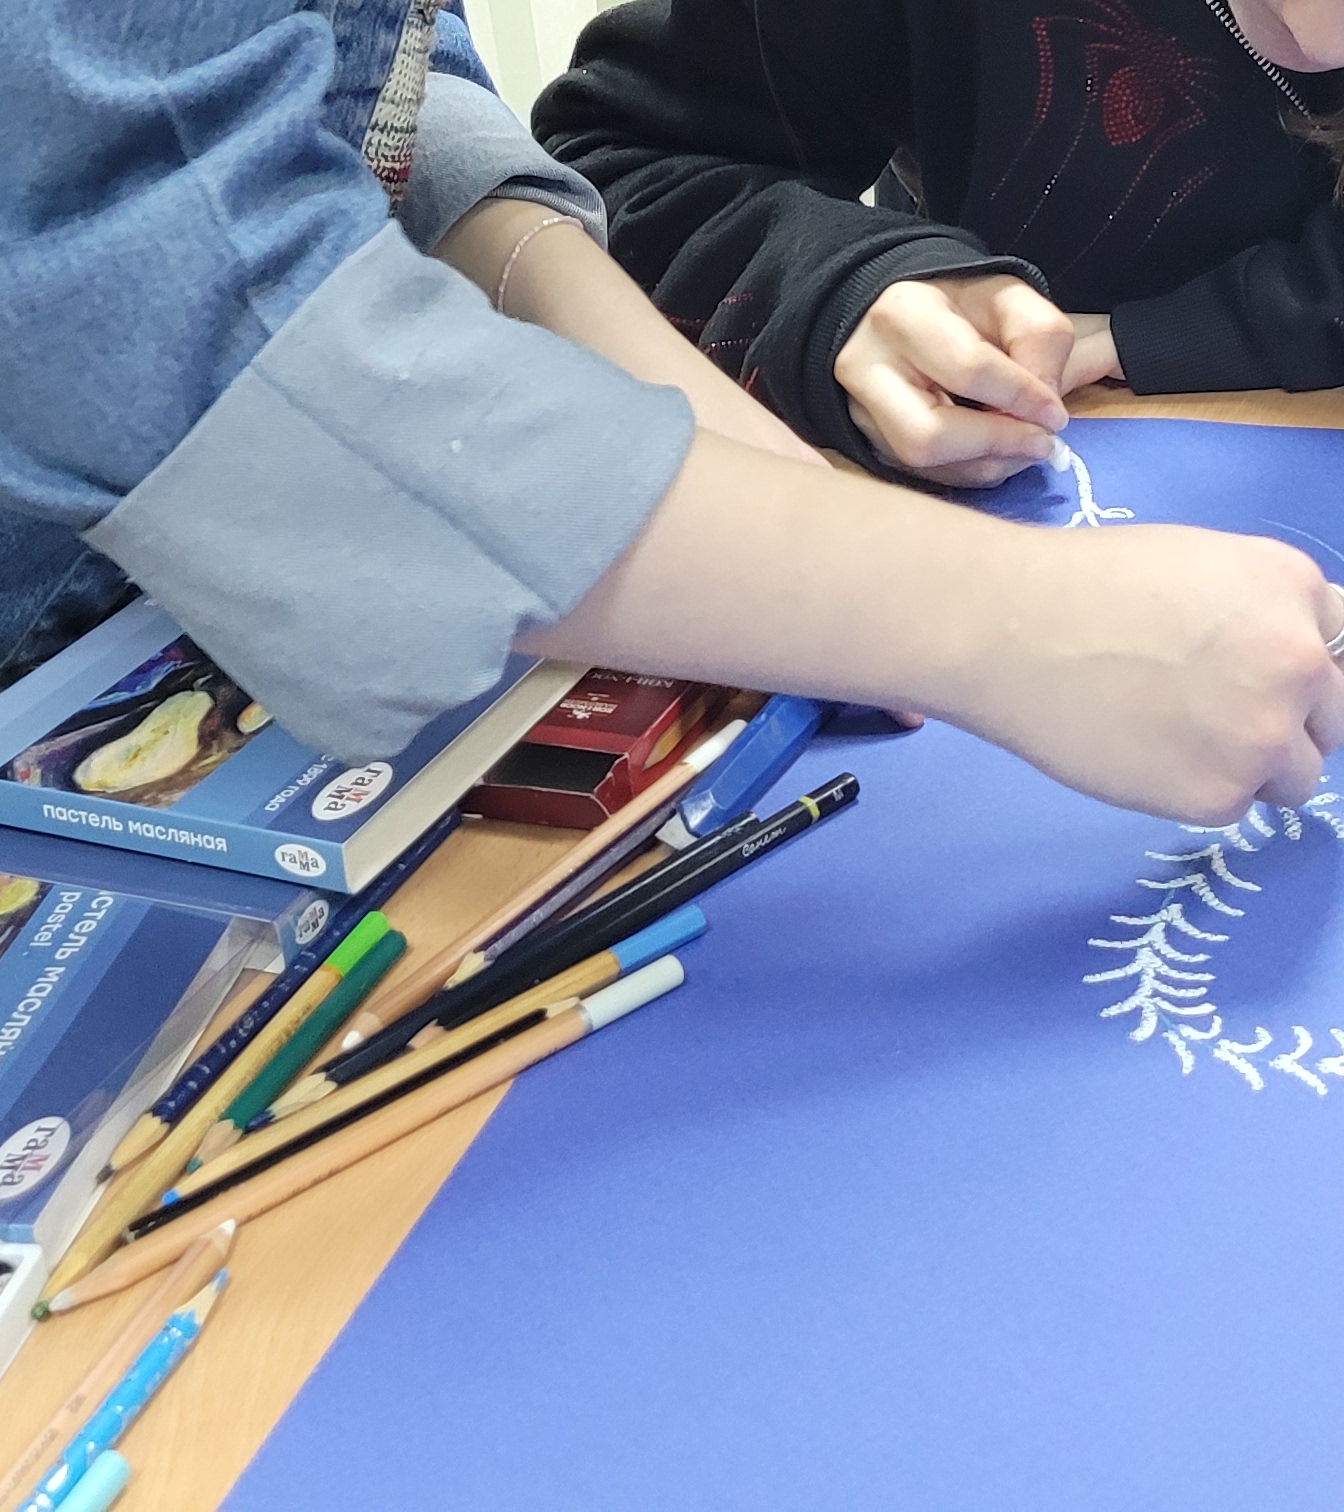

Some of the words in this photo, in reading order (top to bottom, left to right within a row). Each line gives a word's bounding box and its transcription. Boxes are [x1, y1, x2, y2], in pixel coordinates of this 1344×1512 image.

[264, 785, 300, 813] года
[42, 802, 124, 832] пастель
[128, 820, 228, 853] масляная
[29, 891, 83, 947] pastel
[54, 889, 114, 960] стель
